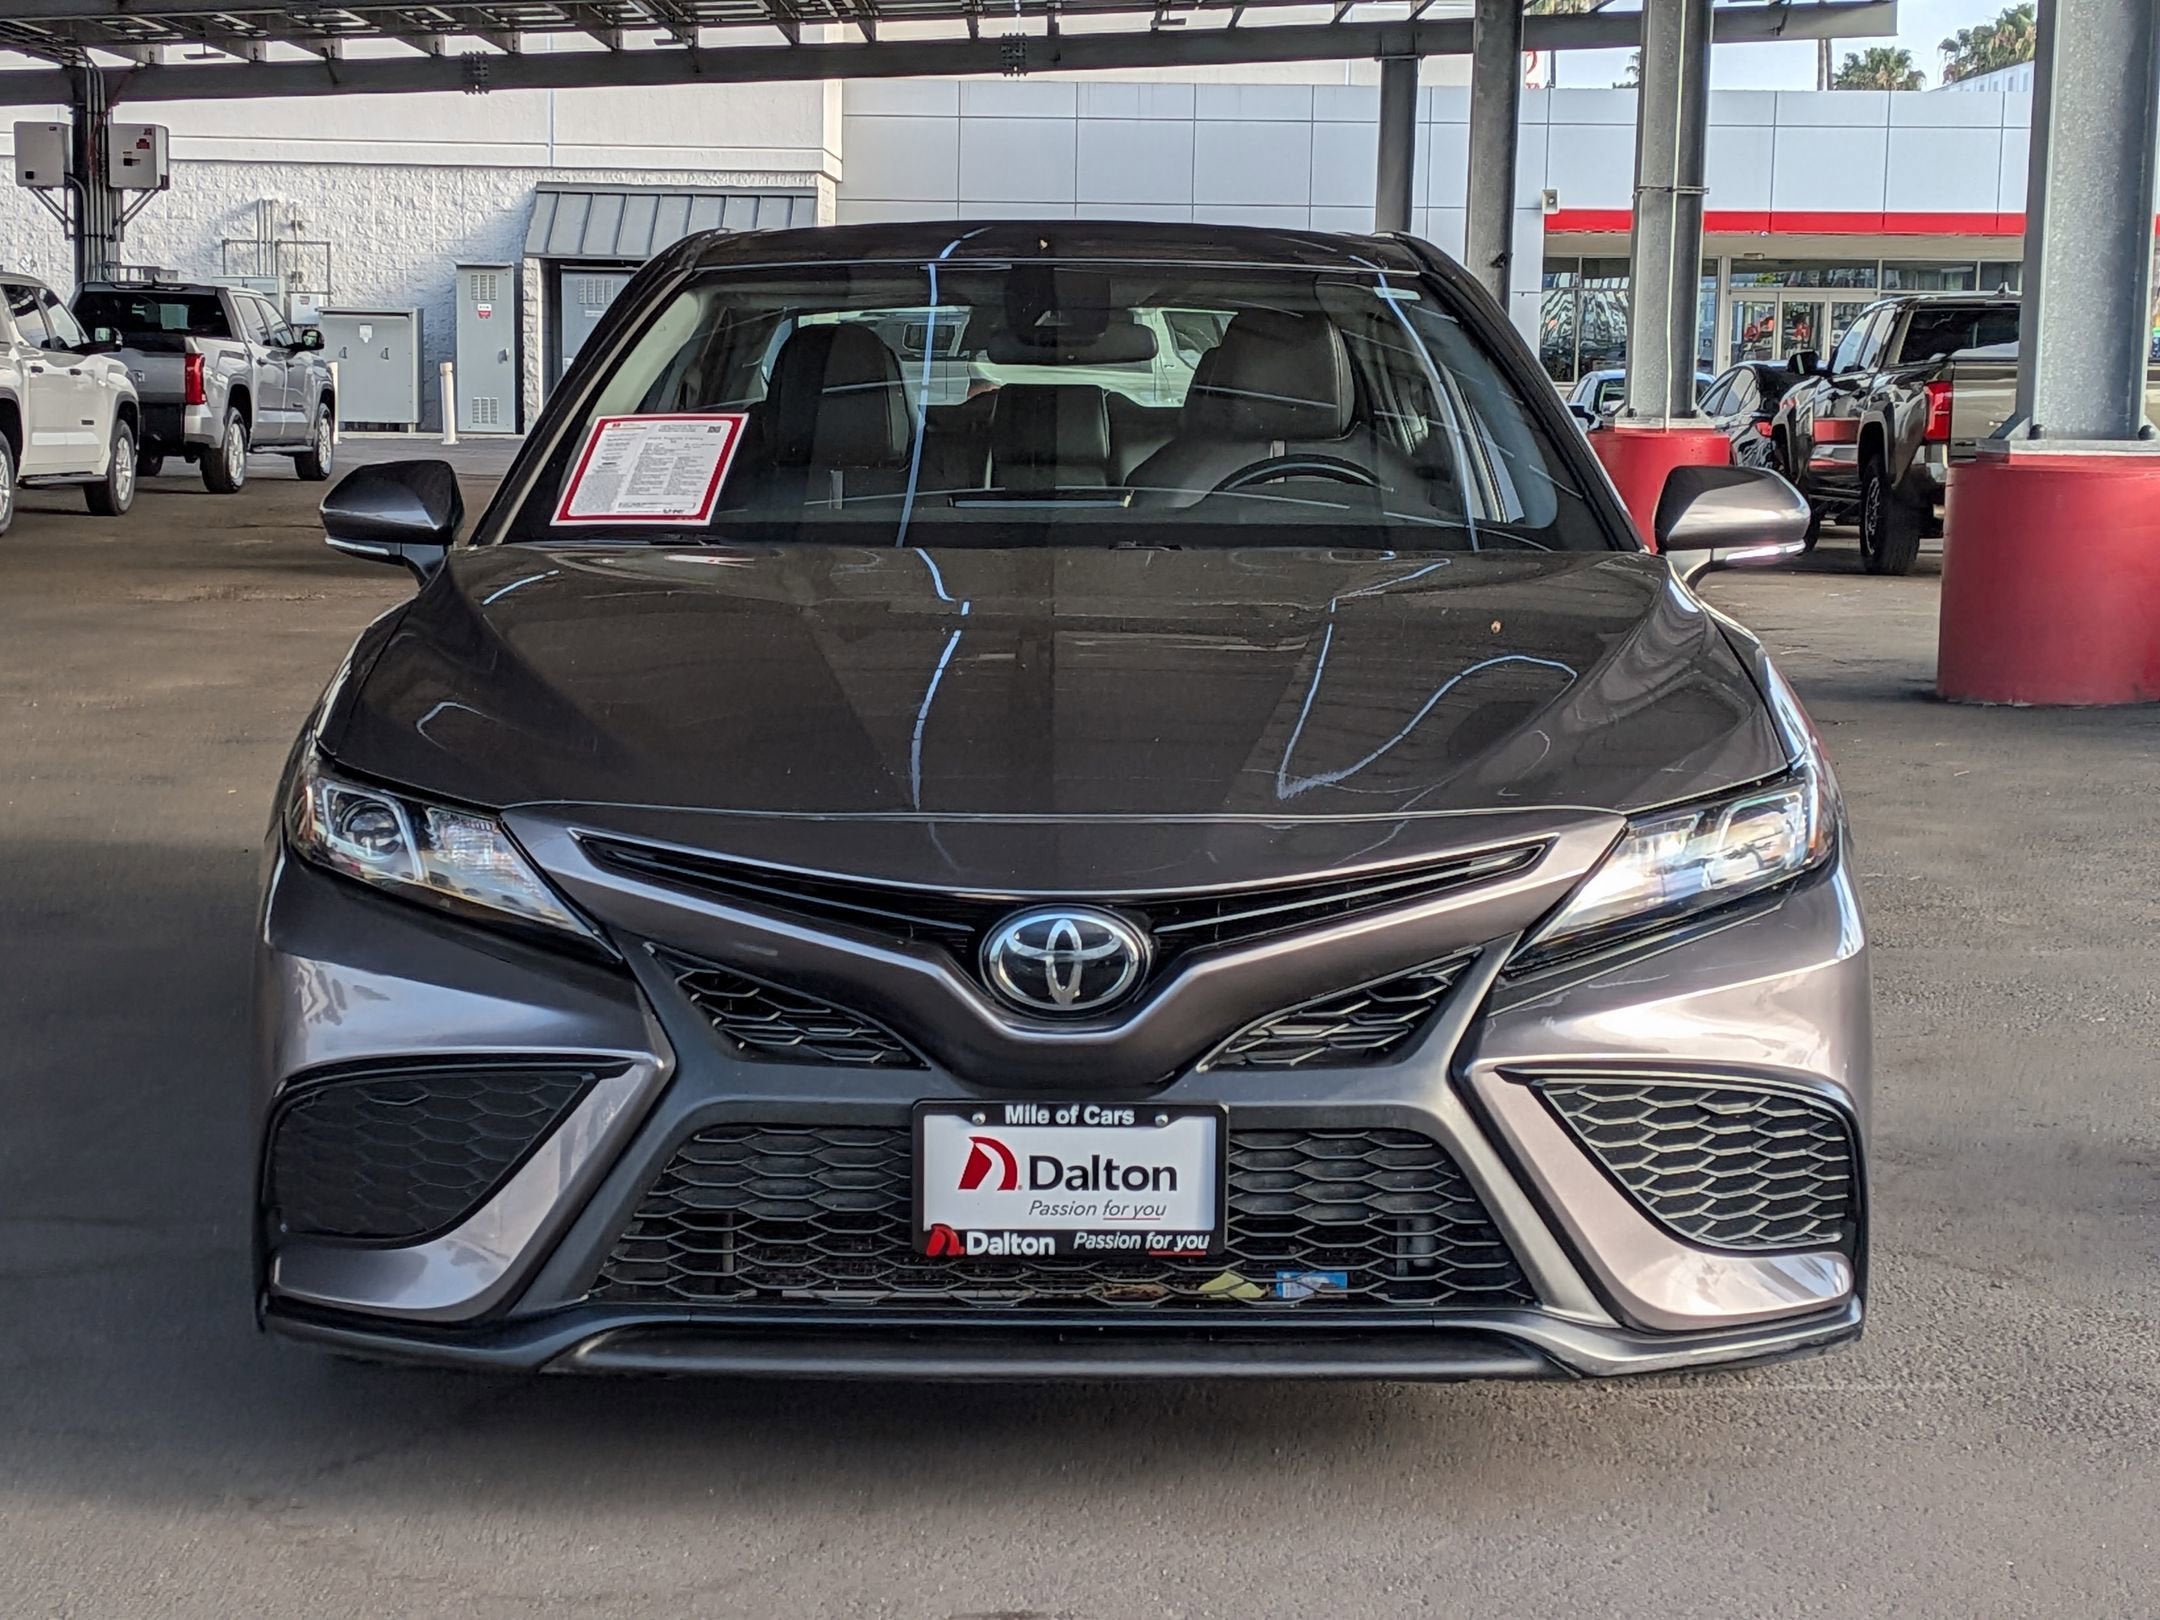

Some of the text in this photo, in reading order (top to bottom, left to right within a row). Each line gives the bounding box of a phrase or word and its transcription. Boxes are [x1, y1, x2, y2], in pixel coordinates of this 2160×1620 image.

[1004, 1105, 1136, 1126] Mile of Cars
[1028, 1154, 1178, 1192] Dalton
[1028, 1200, 1167, 1219] Passion for you
[966, 1231, 1210, 1256] Dalton Passion for you
